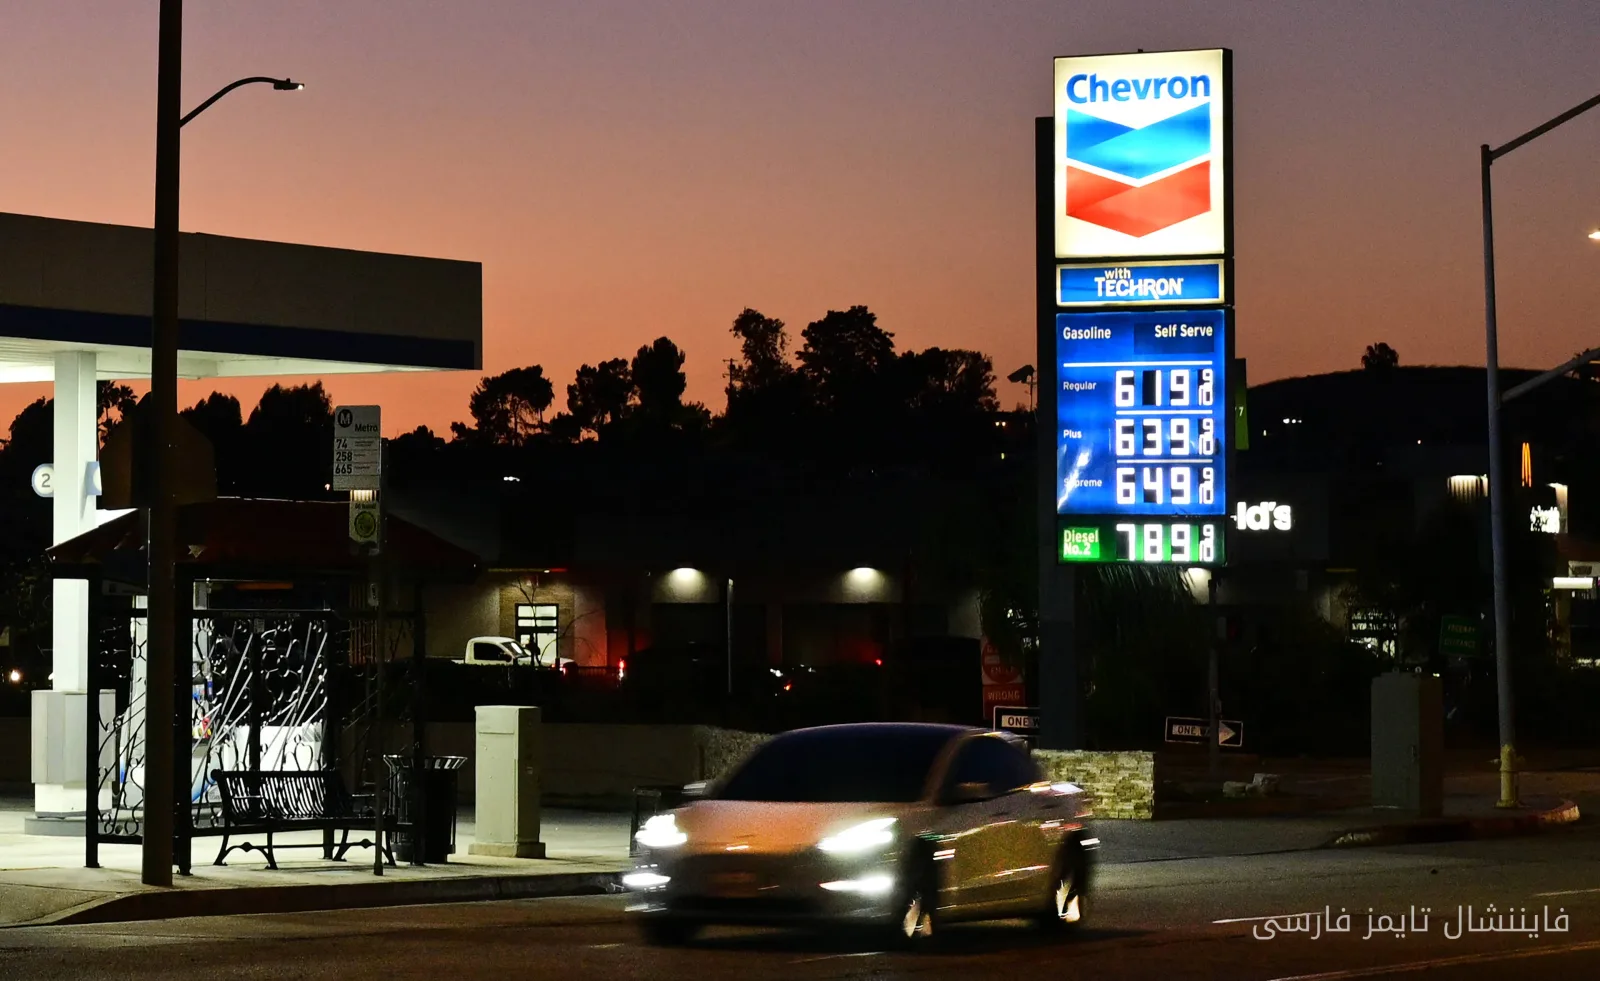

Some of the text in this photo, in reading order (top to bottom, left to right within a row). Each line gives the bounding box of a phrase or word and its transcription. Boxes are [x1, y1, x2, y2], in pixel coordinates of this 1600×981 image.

[1066, 73, 1211, 104] Chevron
[1104, 267, 1131, 280] with
[1094, 277, 1180, 299] TECHRON
[1063, 326, 1112, 340] Gasoline
[1154, 324, 1213, 338] Self Serve
[1063, 381, 1097, 392] Regular
[355, 423, 378, 432] Metro
[1063, 429, 1082, 438] Plus
[336, 439, 348, 450] 74
[336, 451, 353, 462] 258
[335, 463, 352, 475] 665
[41, 473, 51, 488] 2
[1063, 478, 1103, 488] Spreme
[1063, 529, 1099, 543] Diesel
[1063, 542, 1091, 556] No.2
[987, 690, 1020, 701] WRONG
[1007, 716, 1029, 727] ONE
[1177, 725, 1197, 735] ONE
